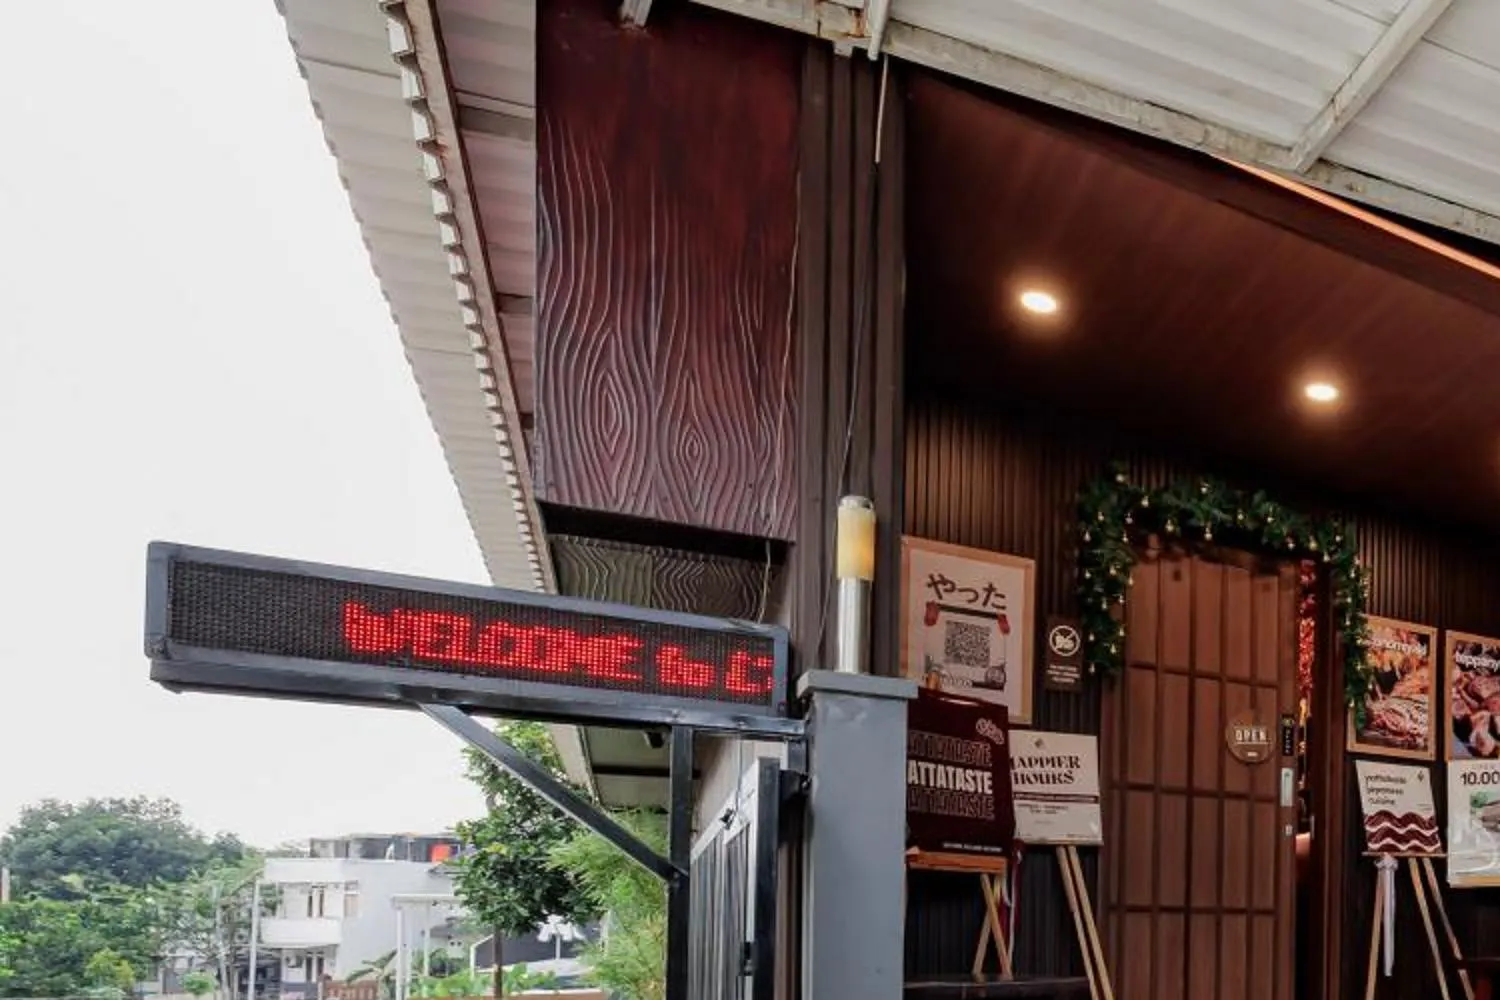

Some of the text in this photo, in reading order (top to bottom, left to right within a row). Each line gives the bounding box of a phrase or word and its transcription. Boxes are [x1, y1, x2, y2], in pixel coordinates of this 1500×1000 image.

[927, 572, 1007, 609] やった
[1235, 728, 1267, 741] OPEN
[1013, 770, 1075, 785] HOURS
[1460, 771, 1500, 786] 10.00
